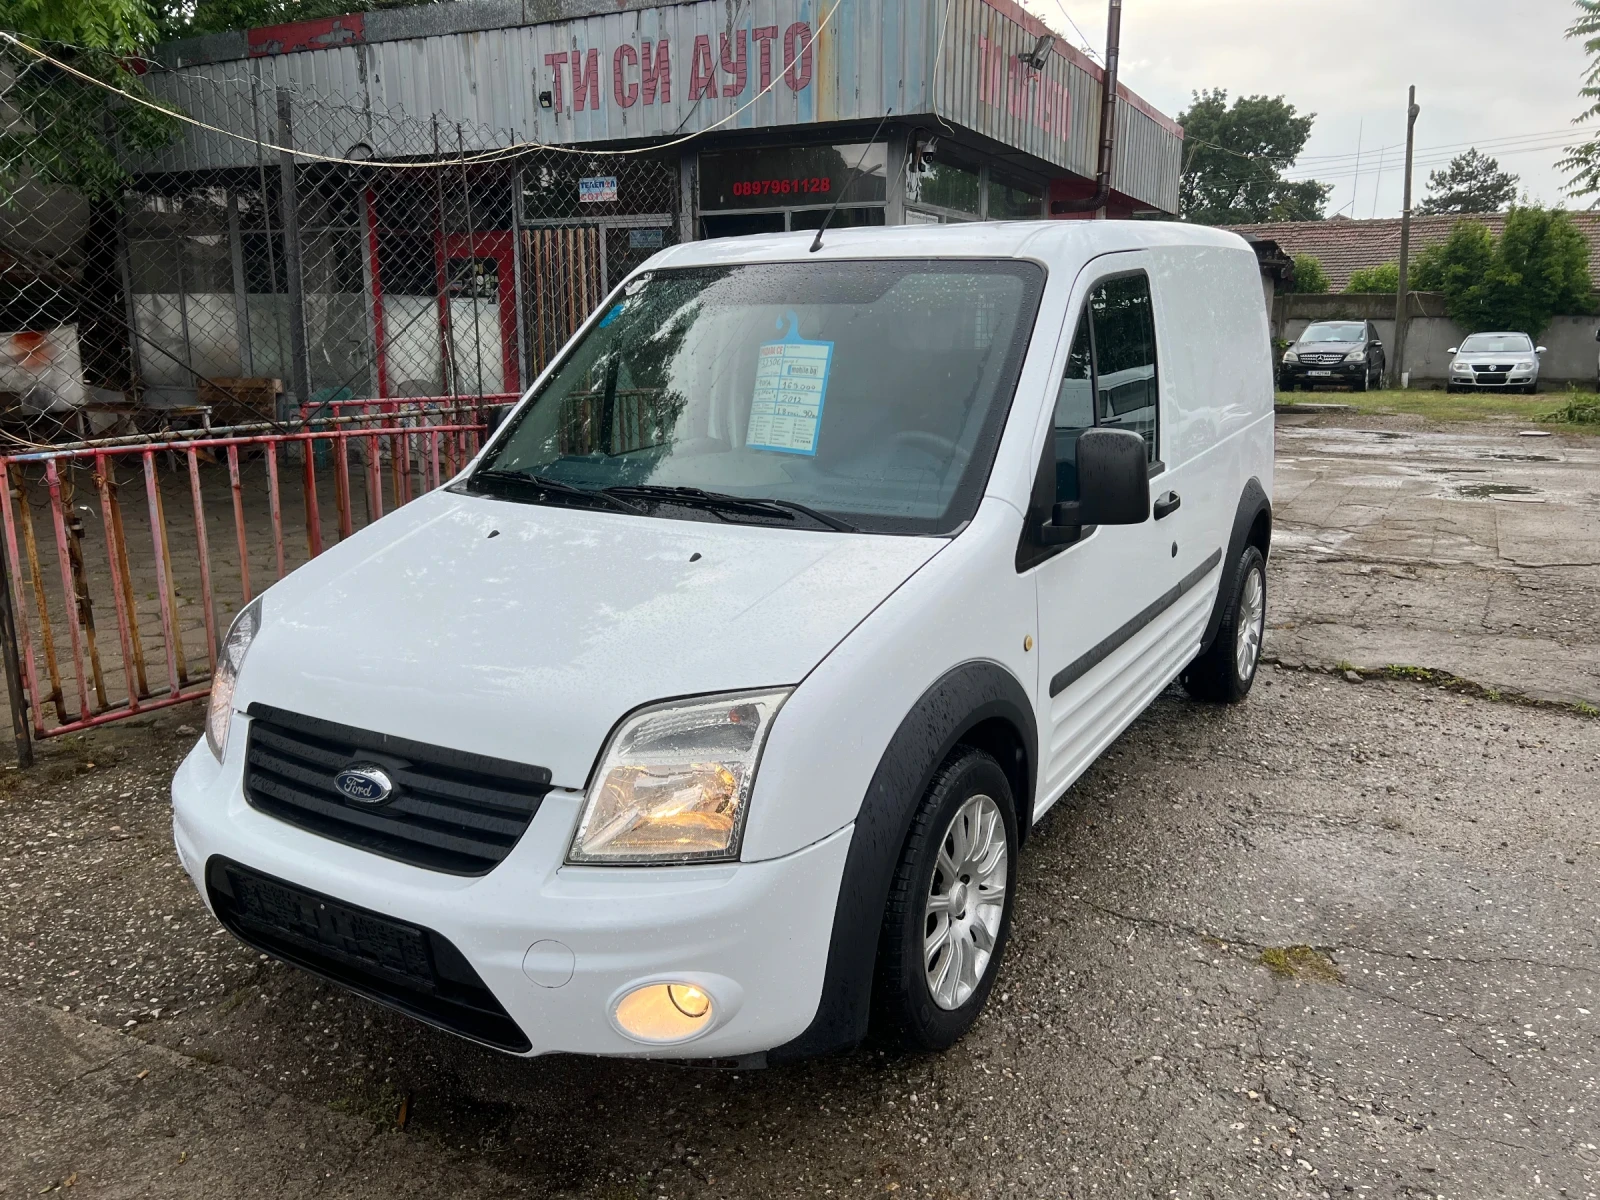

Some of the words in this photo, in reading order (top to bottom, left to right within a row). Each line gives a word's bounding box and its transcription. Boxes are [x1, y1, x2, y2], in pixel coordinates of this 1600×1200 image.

[544, 48, 599, 113] ТИ
[613, 39, 670, 108] СИ
[688, 21, 813, 101] АУТО
[733, 177, 831, 196] 0897961128
[344, 776, 373, 797] Ford
